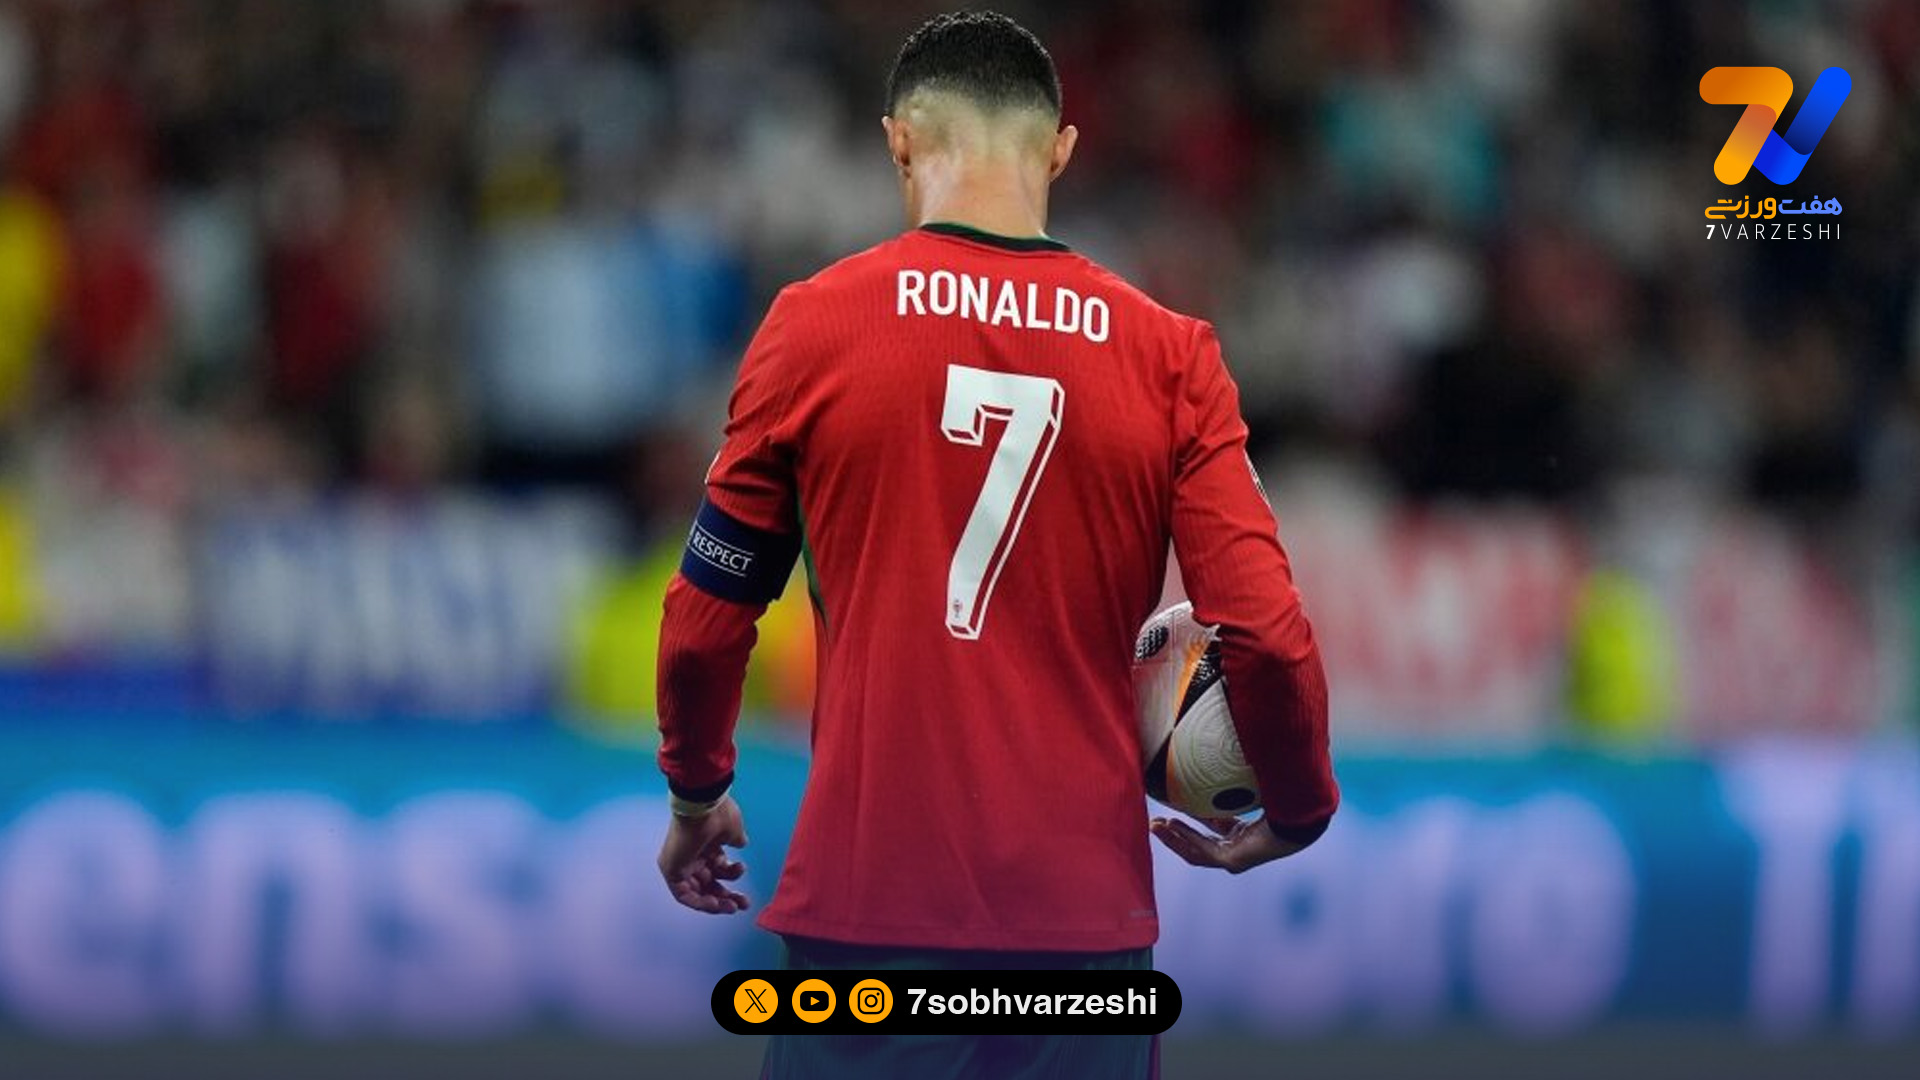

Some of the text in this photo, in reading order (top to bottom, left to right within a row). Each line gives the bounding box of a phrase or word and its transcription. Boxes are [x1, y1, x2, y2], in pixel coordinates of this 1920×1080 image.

[897, 269, 1110, 342] RONALDO
[940, 364, 1065, 640] 7
[692, 531, 753, 571] RESPECT
